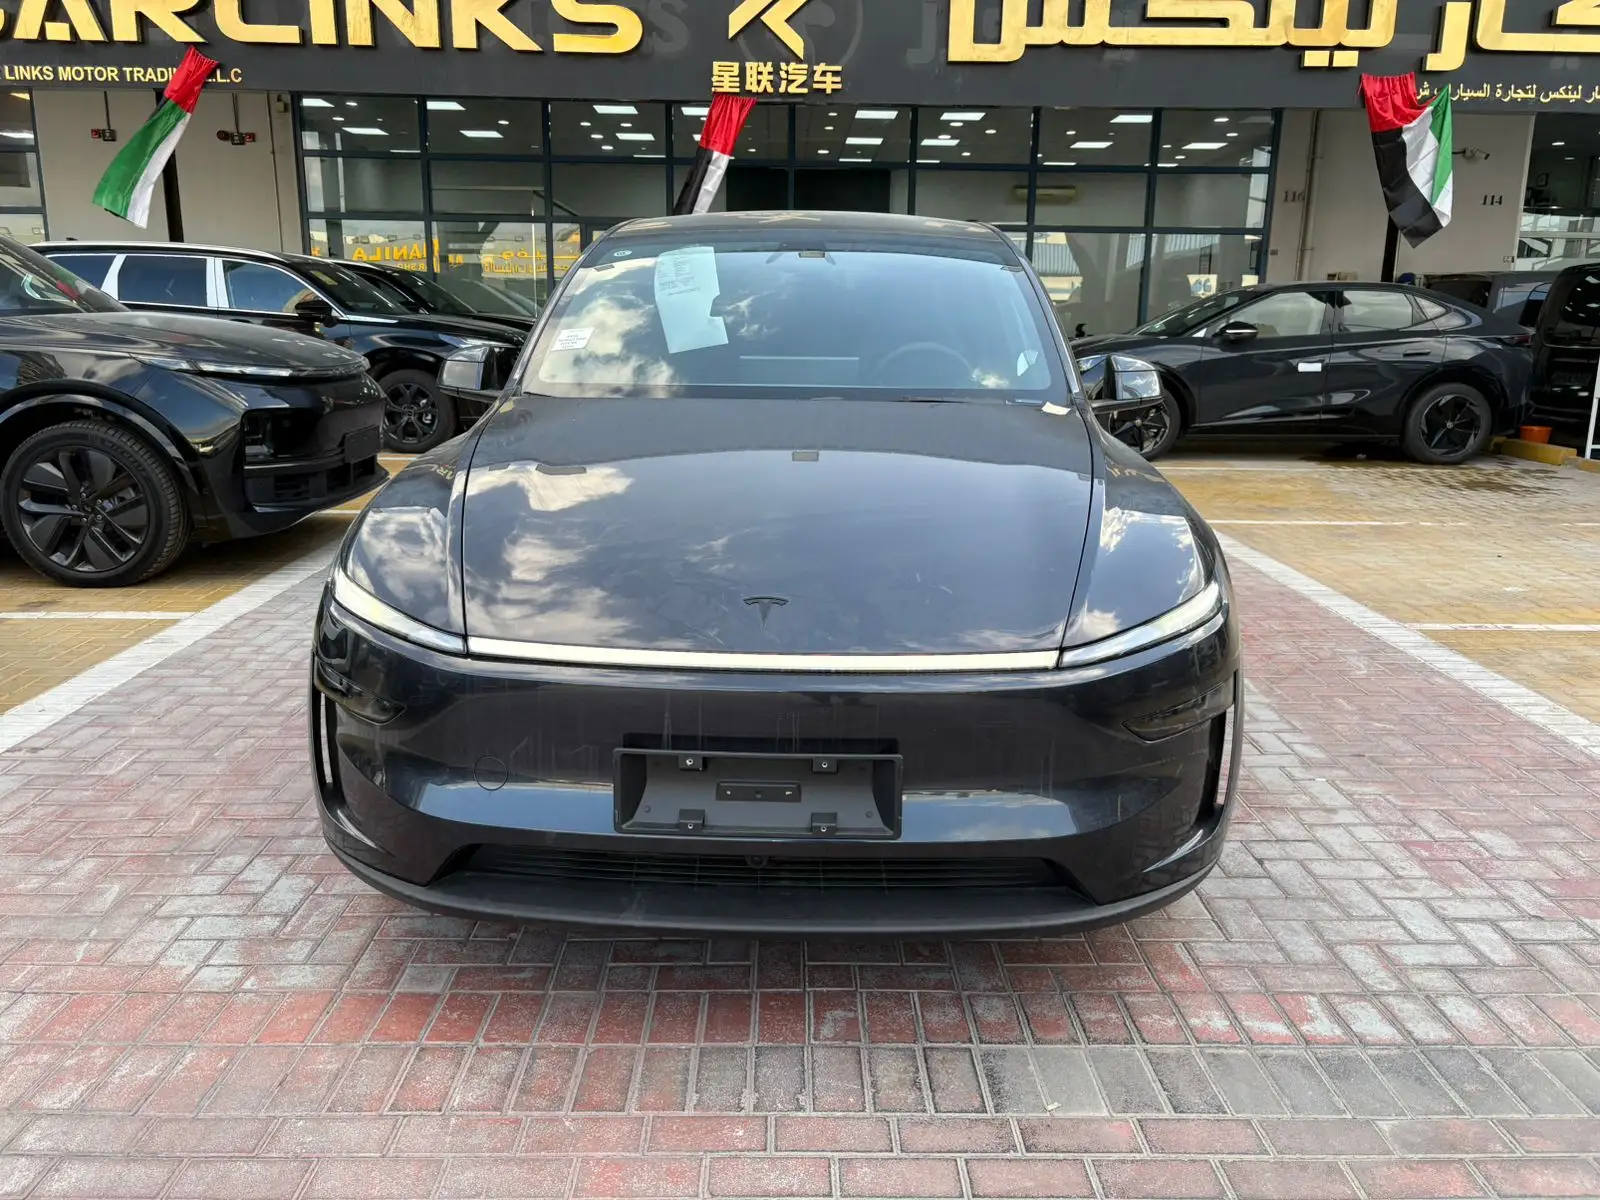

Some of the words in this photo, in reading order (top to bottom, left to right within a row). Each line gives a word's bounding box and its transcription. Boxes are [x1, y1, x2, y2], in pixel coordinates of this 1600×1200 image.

[0, 0, 643, 53] ARLINKS
[4, 65, 54, 80] LINKS
[58, 66, 119, 81] MOTOR
[122, 67, 177, 82] TRADI
[206, 68, 242, 83] .L.C
[712, 61, 843, 94] 星联汽车
[1495, 83, 1537, 102] لتجارة
[1540, 84, 1582, 103] لينكس
[1482, 195, 1503, 206] 114
